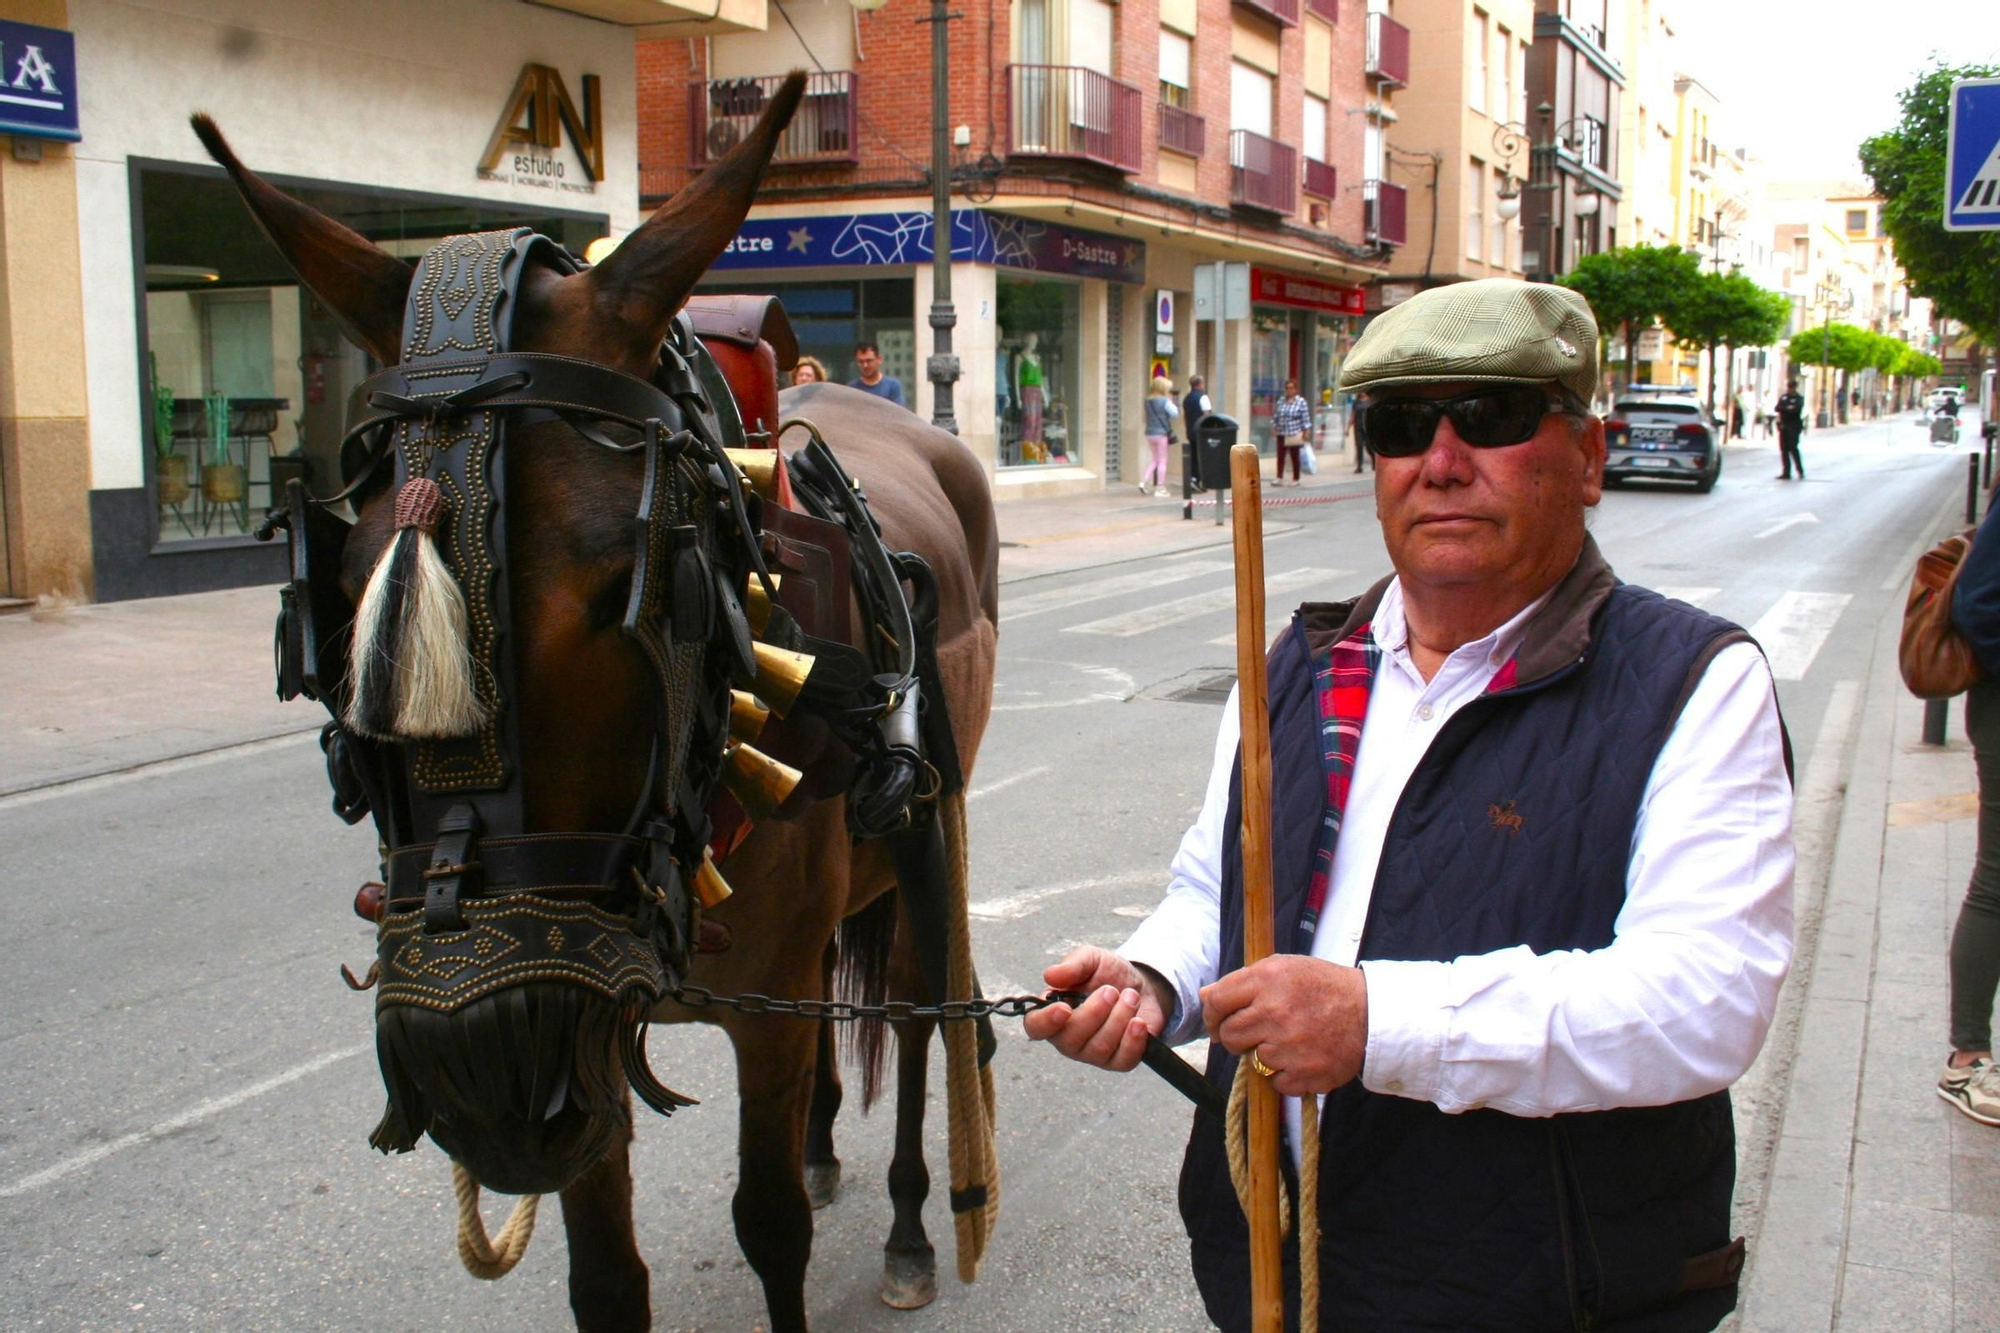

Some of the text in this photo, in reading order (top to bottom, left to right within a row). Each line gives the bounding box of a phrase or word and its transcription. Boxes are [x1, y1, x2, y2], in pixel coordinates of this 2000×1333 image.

[476, 62, 605, 183] AN
[514, 154, 565, 178] estudio
[724, 235, 773, 253] stre
[1063, 239, 1118, 265] D-Sastre
